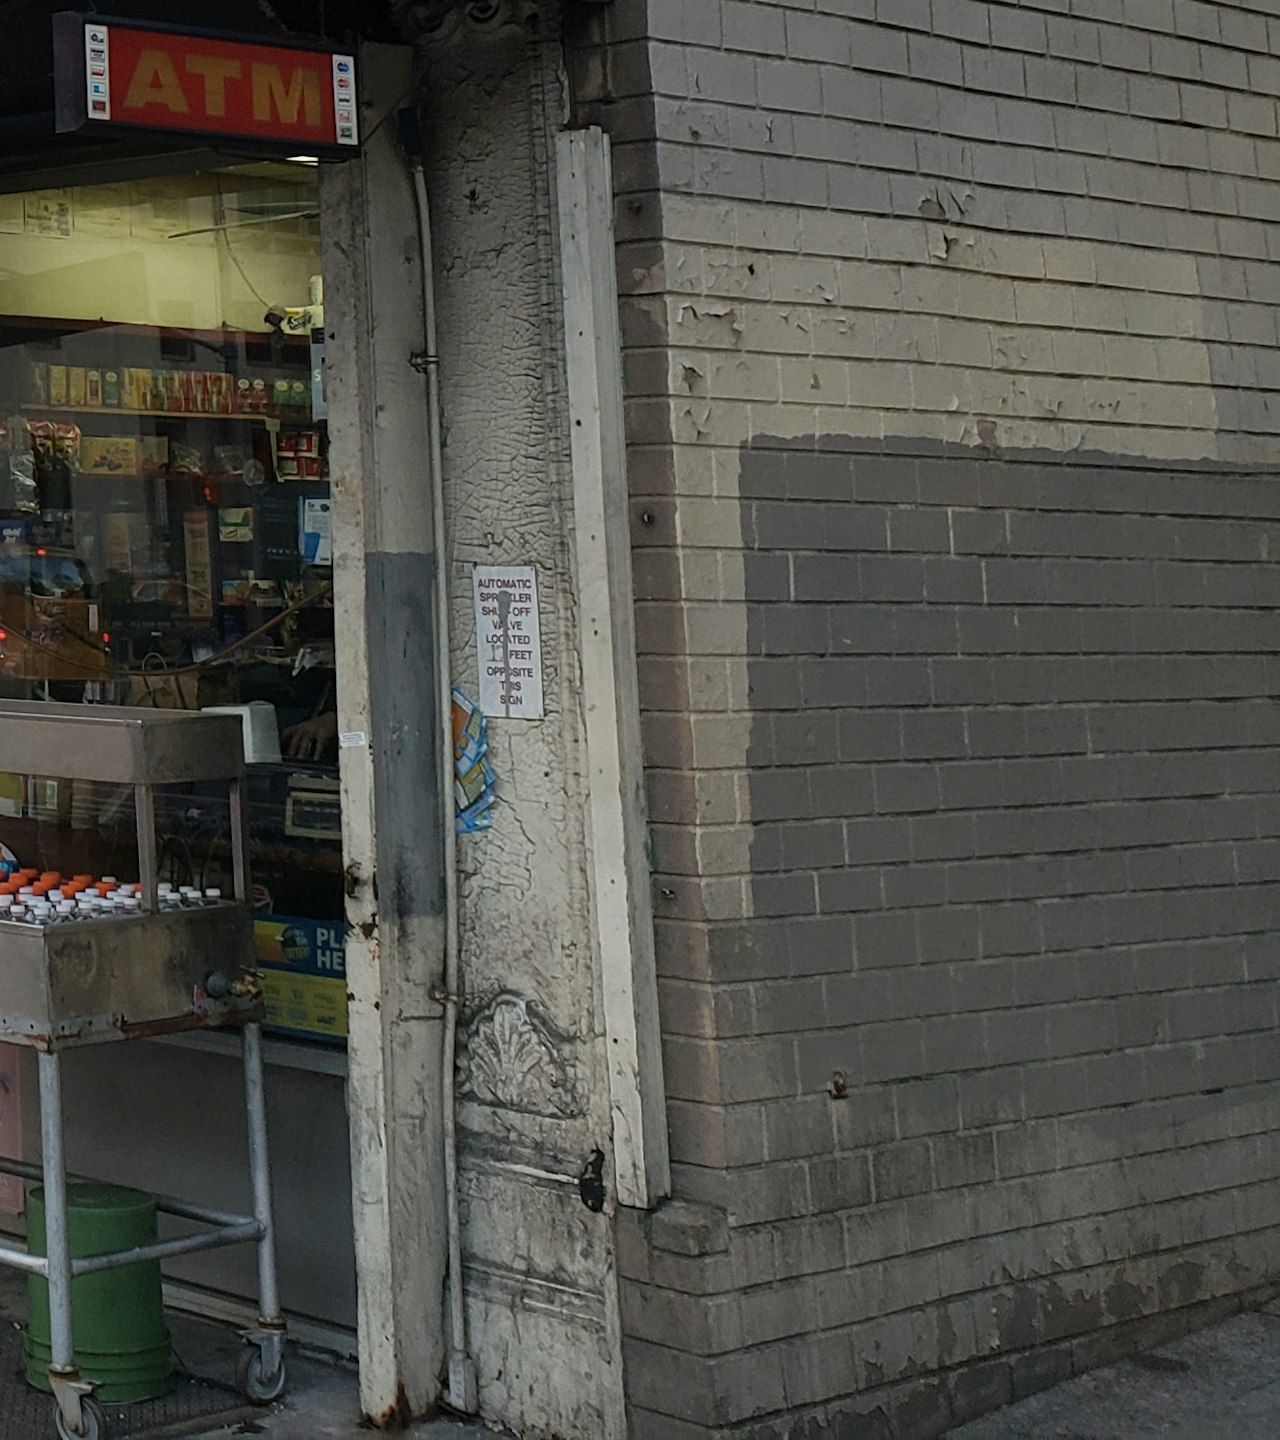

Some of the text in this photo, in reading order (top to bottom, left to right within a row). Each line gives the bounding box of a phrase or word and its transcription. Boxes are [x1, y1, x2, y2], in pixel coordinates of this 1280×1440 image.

[123, 48, 322, 127] ATM
[478, 579, 532, 589] AUTOMATIC
[510, 650, 533, 660] FEET
